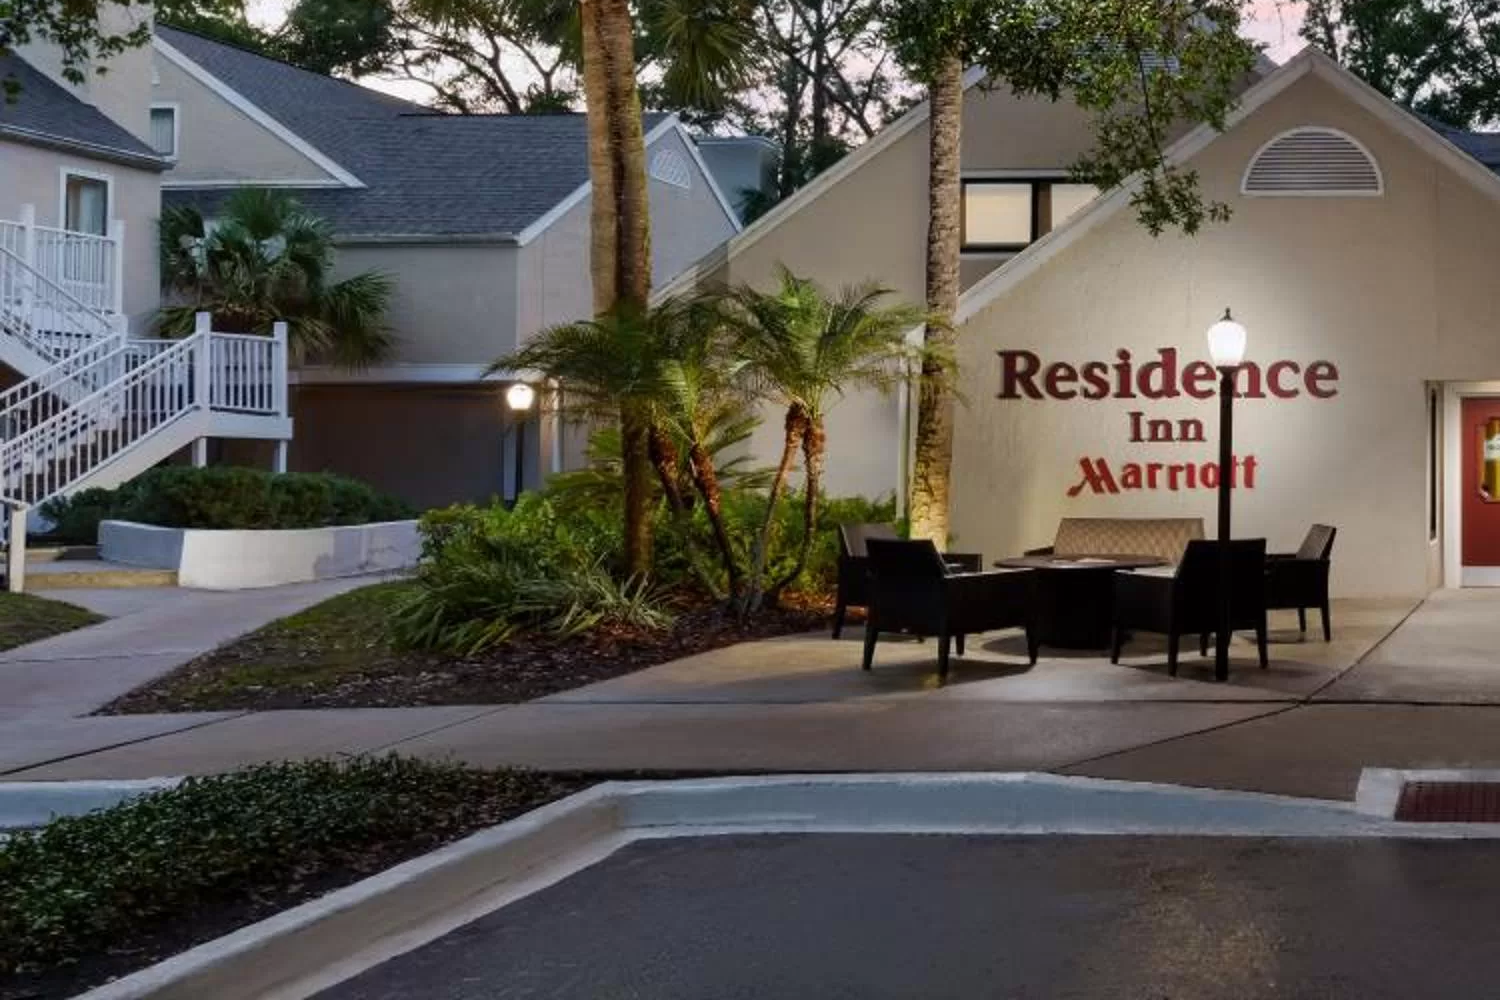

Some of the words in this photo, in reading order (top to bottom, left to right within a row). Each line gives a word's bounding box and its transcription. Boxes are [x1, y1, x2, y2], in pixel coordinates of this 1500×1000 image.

[996, 347, 1339, 400] Residence
[1128, 411, 1207, 443] Inn
[1066, 455, 1257, 498] Marriott
